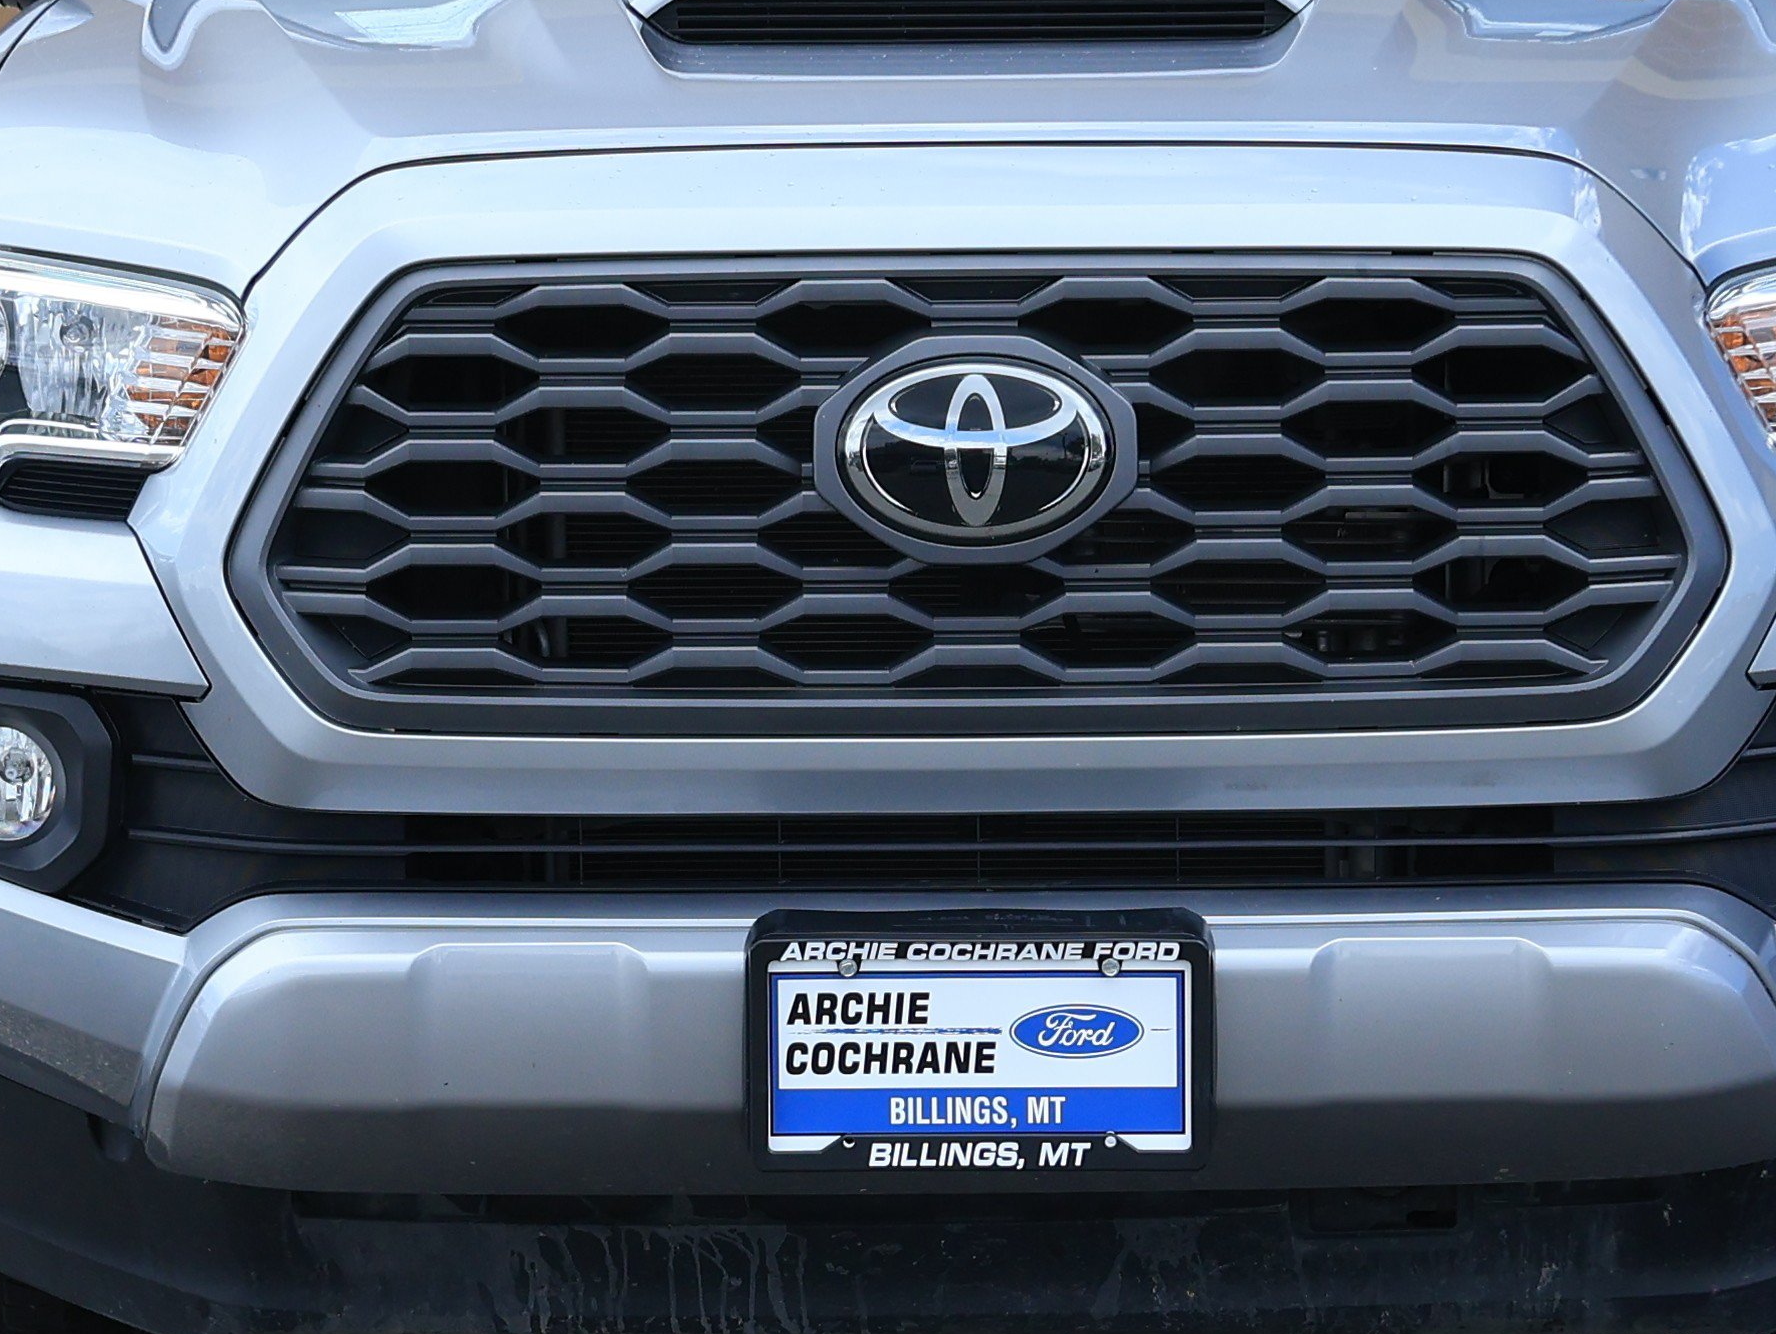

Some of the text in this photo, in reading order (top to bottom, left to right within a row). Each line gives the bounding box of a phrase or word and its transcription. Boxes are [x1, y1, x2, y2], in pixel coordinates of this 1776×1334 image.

[780, 941, 1181, 961] ARCHIE COCHRANE FORD
[786, 992, 930, 1025] ARCHIE
[1038, 1013, 1115, 1047] Ford
[786, 1041, 997, 1075] COCHRANE
[889, 1095, 1066, 1128] BILLINGS, MT
[868, 1142, 1092, 1169] BILLINGS, MT
